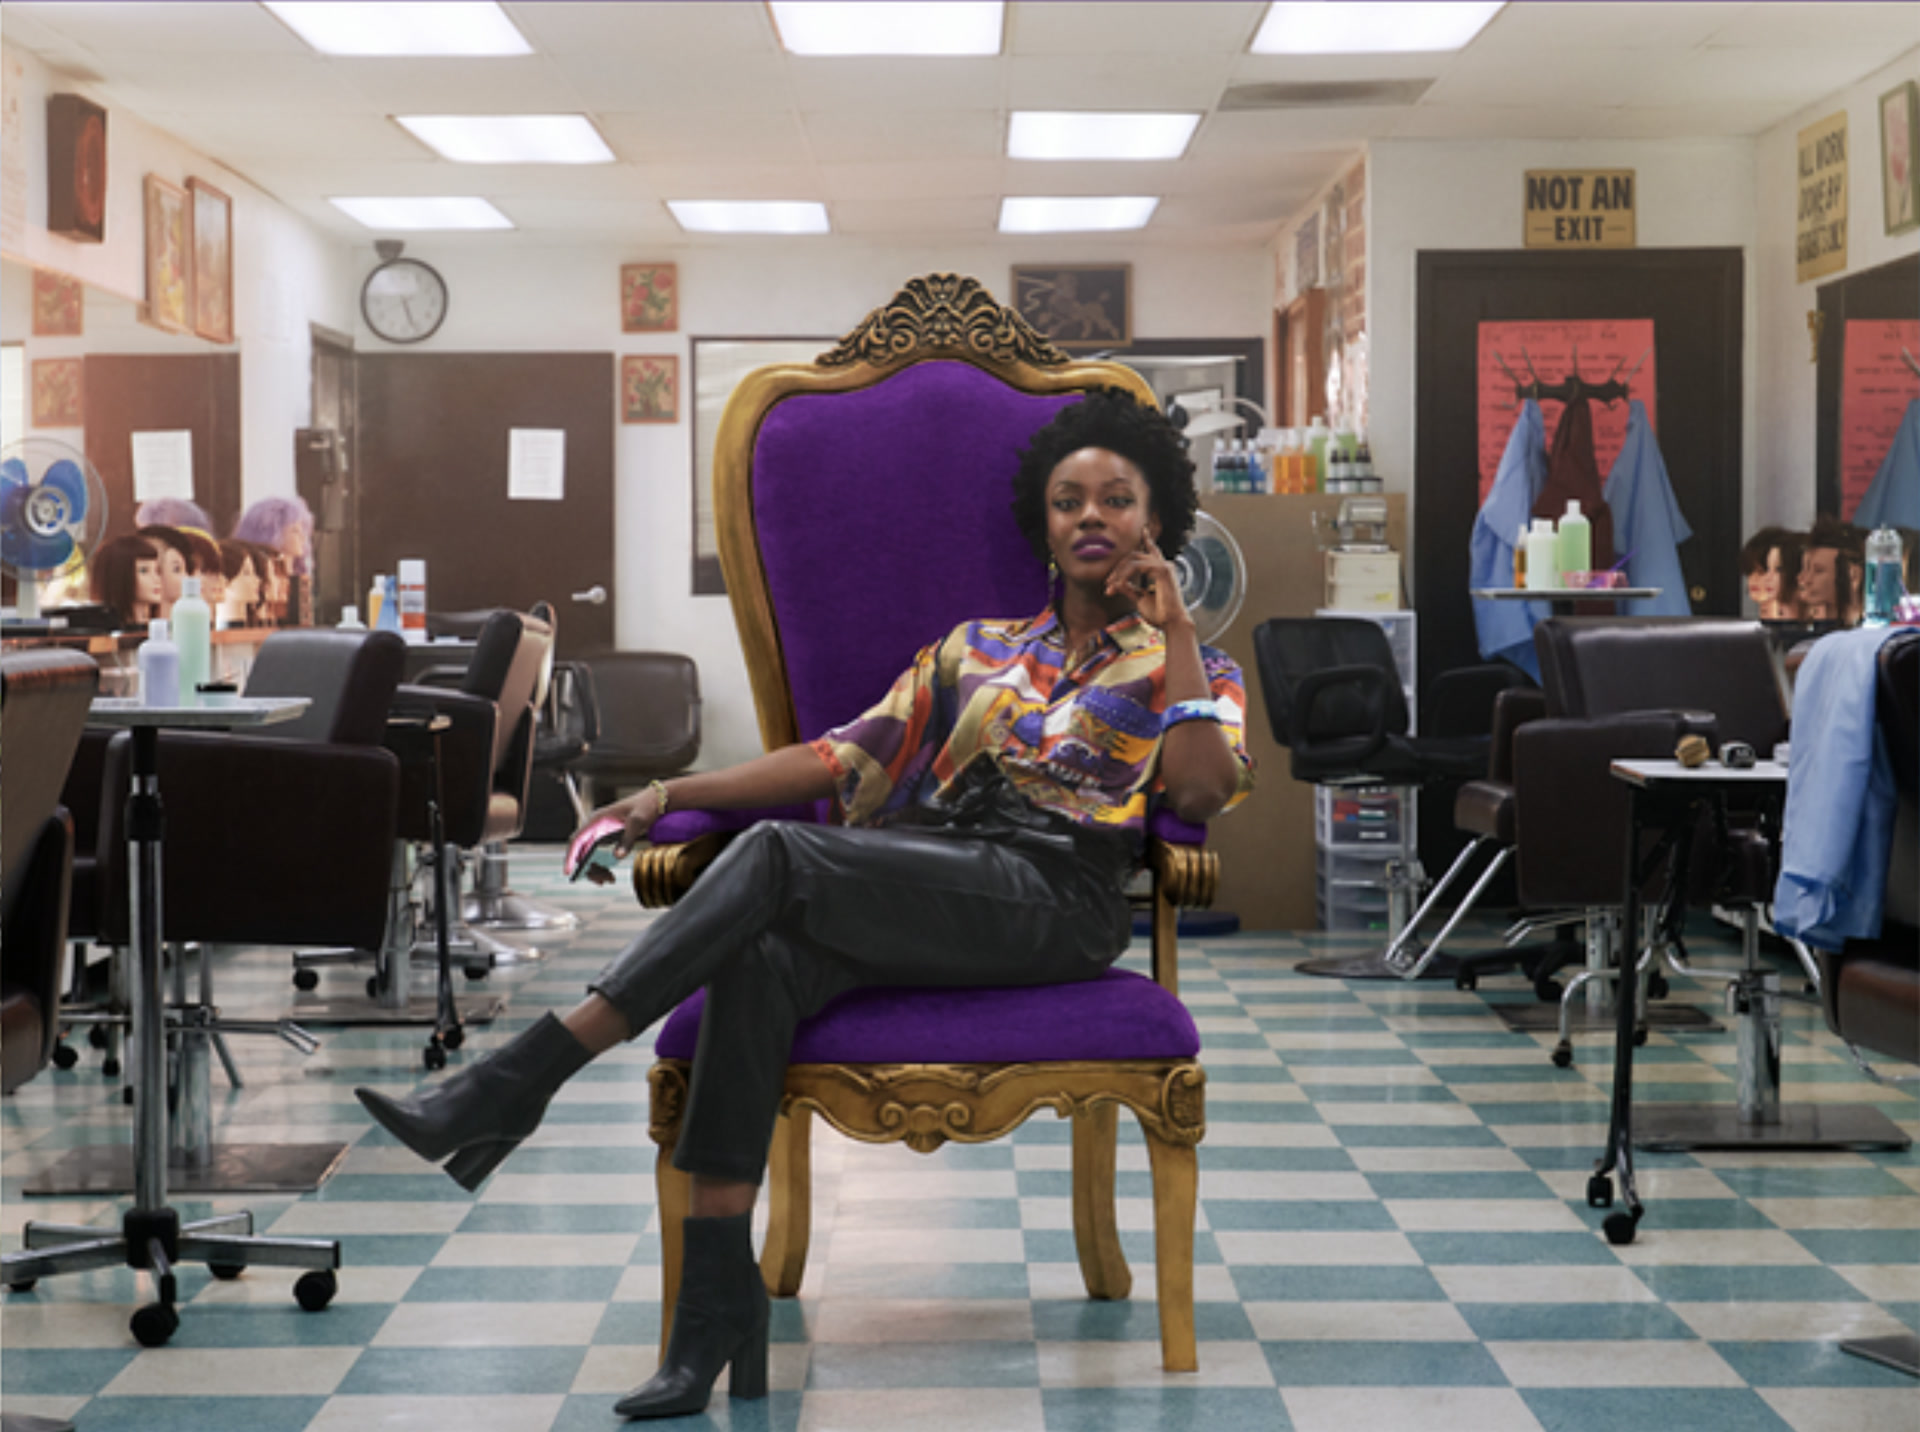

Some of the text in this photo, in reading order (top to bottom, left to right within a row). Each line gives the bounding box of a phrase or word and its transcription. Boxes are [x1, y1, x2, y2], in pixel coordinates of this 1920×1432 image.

[1816, 127, 1846, 171] WORK
[1527, 176, 1632, 211] NOT AN
[1554, 216, 1604, 242] EXIT
